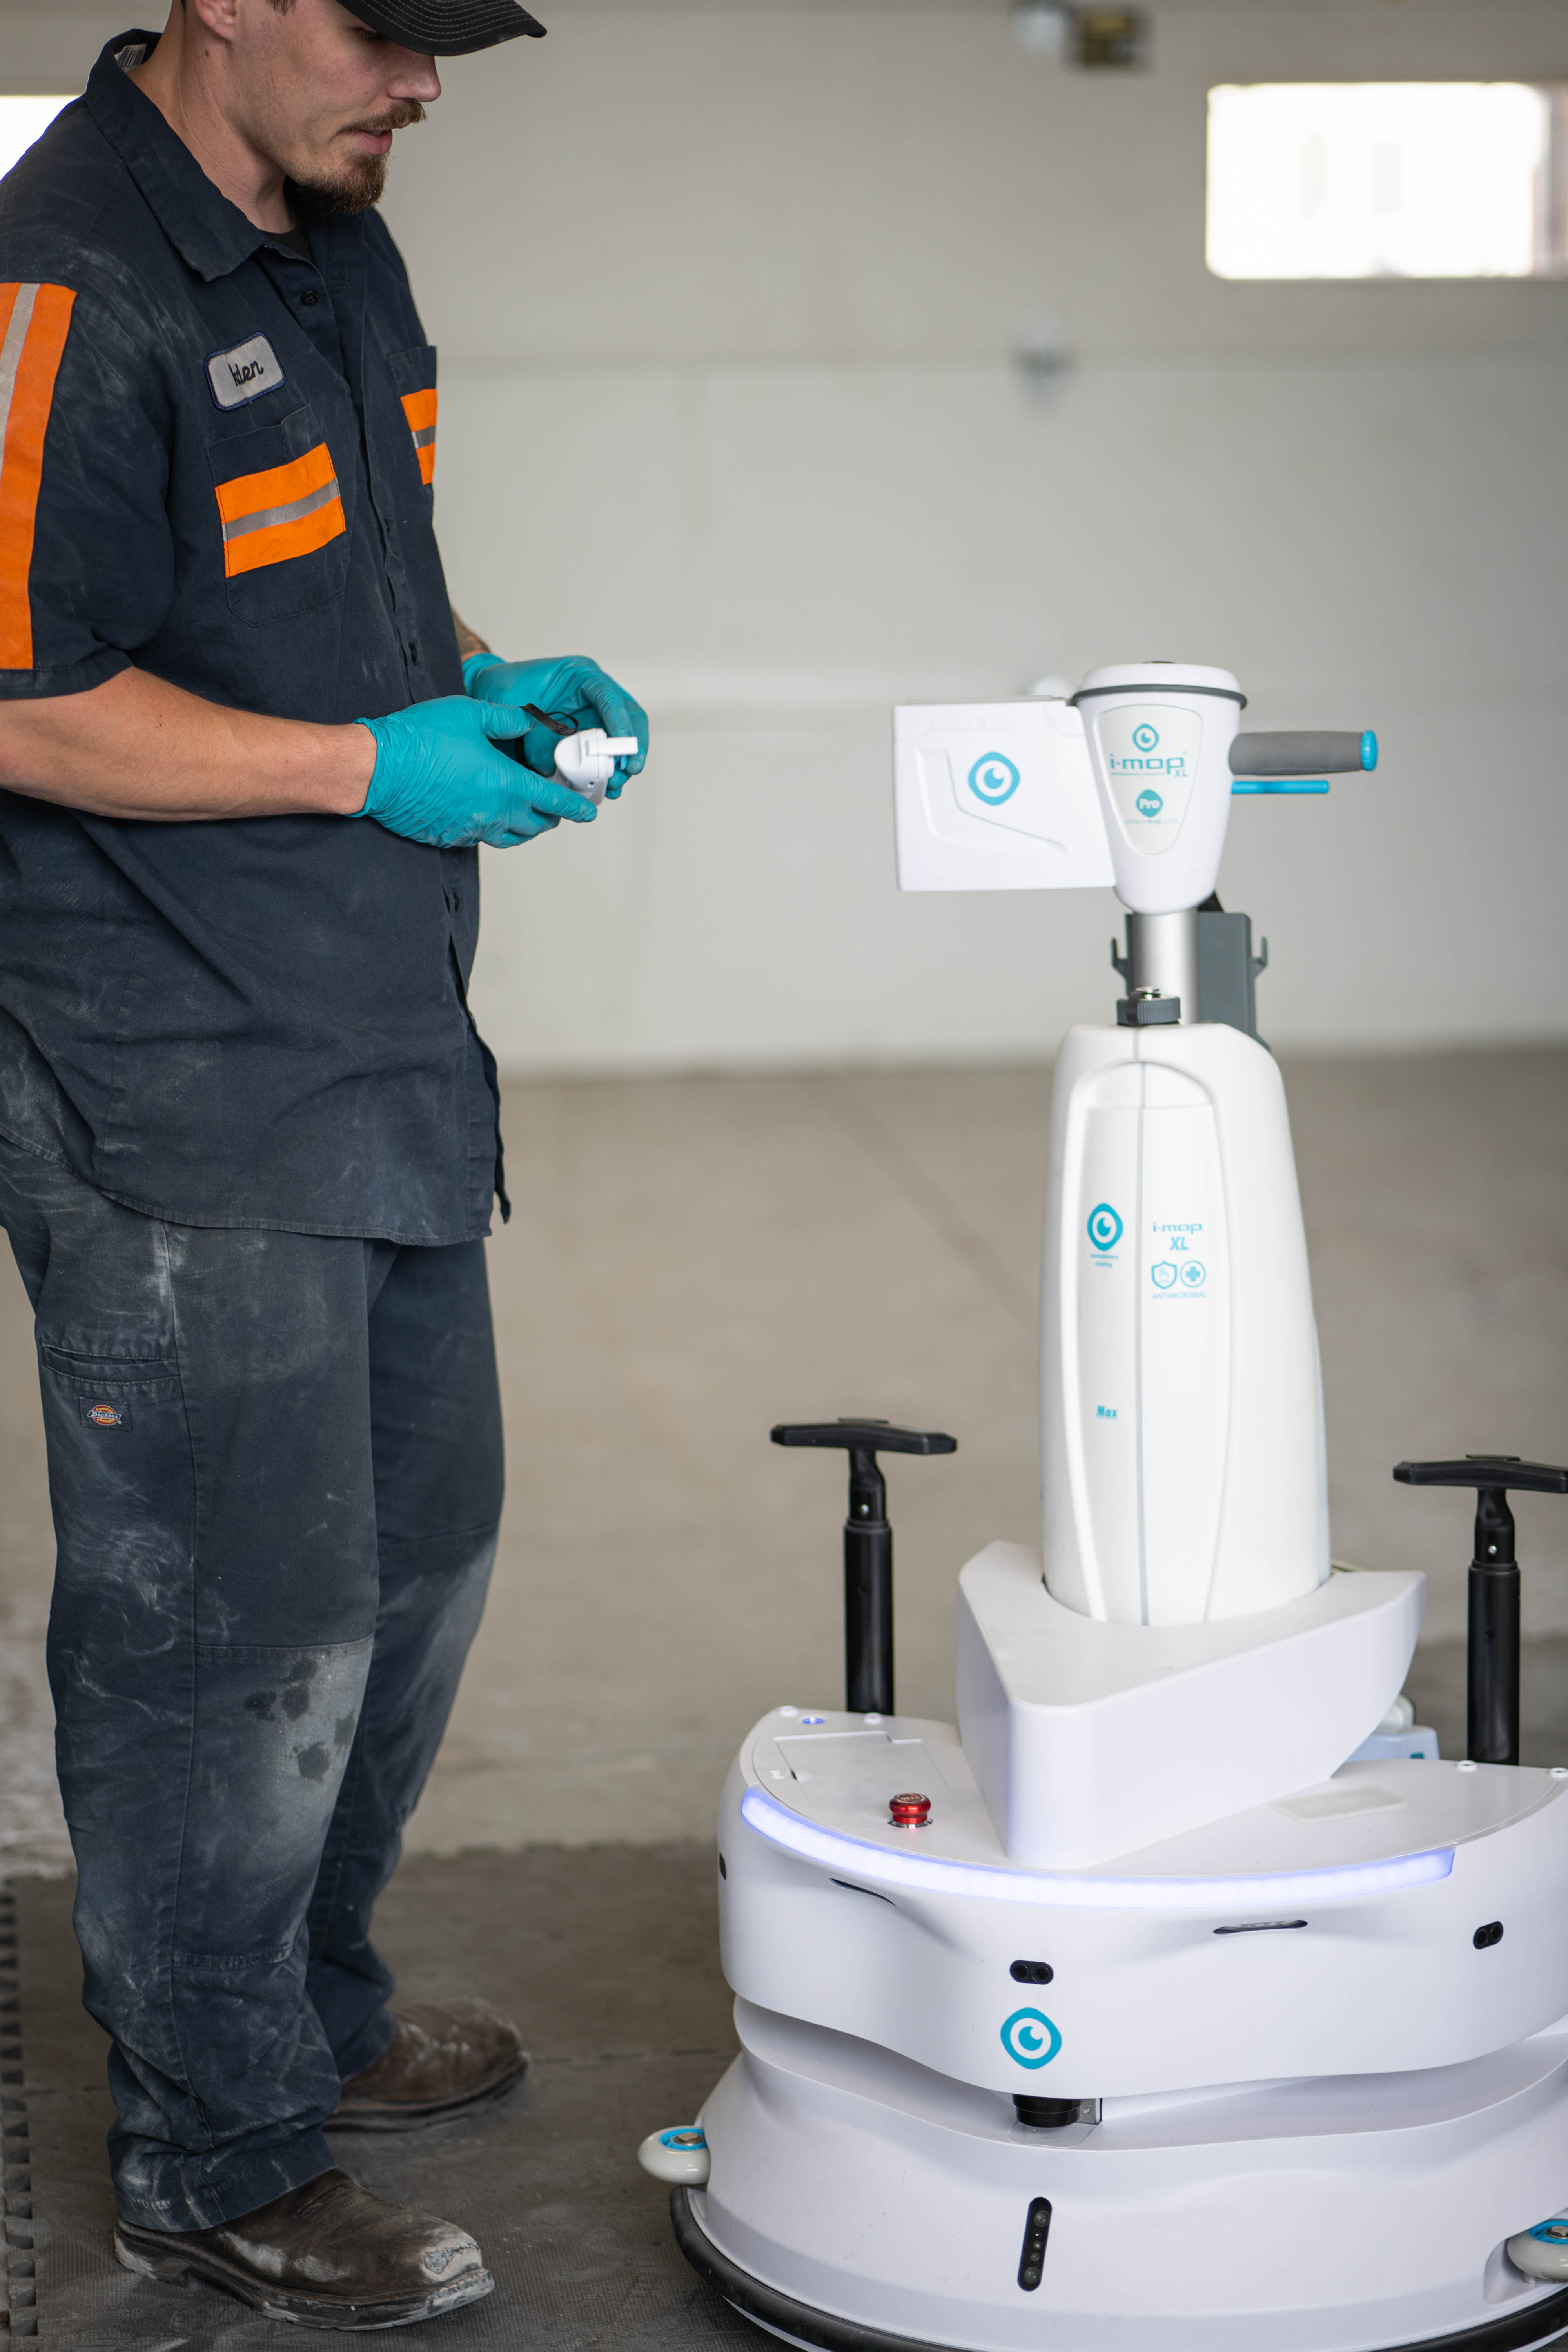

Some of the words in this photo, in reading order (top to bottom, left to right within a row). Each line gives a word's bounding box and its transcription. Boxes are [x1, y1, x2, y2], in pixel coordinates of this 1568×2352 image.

[1109, 754, 1184, 775] i-mop
[1174, 769, 1187, 777] XL
[1139, 798, 1160, 809] Pro
[1153, 1223, 1203, 1234] i-mop
[1169, 1237, 1189, 1251] XL
[1097, 1405, 1117, 1417] Max
